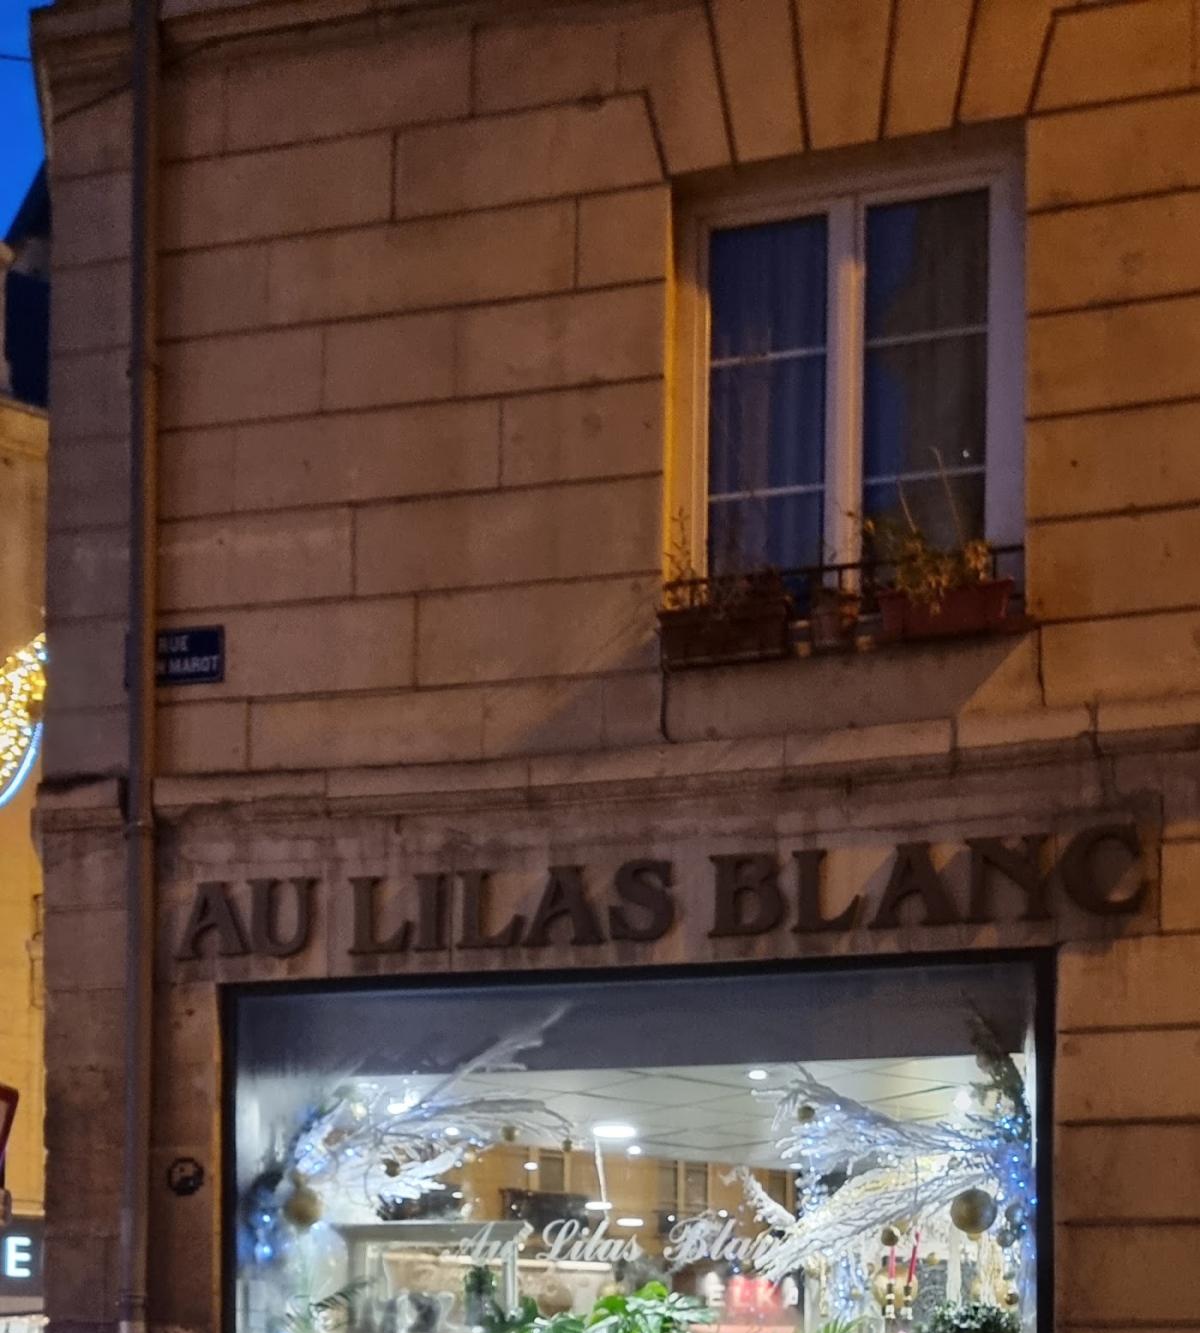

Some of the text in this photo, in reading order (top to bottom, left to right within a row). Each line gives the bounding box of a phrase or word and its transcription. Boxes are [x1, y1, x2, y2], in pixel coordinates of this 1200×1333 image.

[158, 634, 188, 653] RUE
[168, 655, 219, 673] MAROT
[176, 823, 1150, 961] AU LILAS BLANC
[5, 1236, 32, 1278] E
[441, 1209, 792, 1265] Au Lilas Bla
